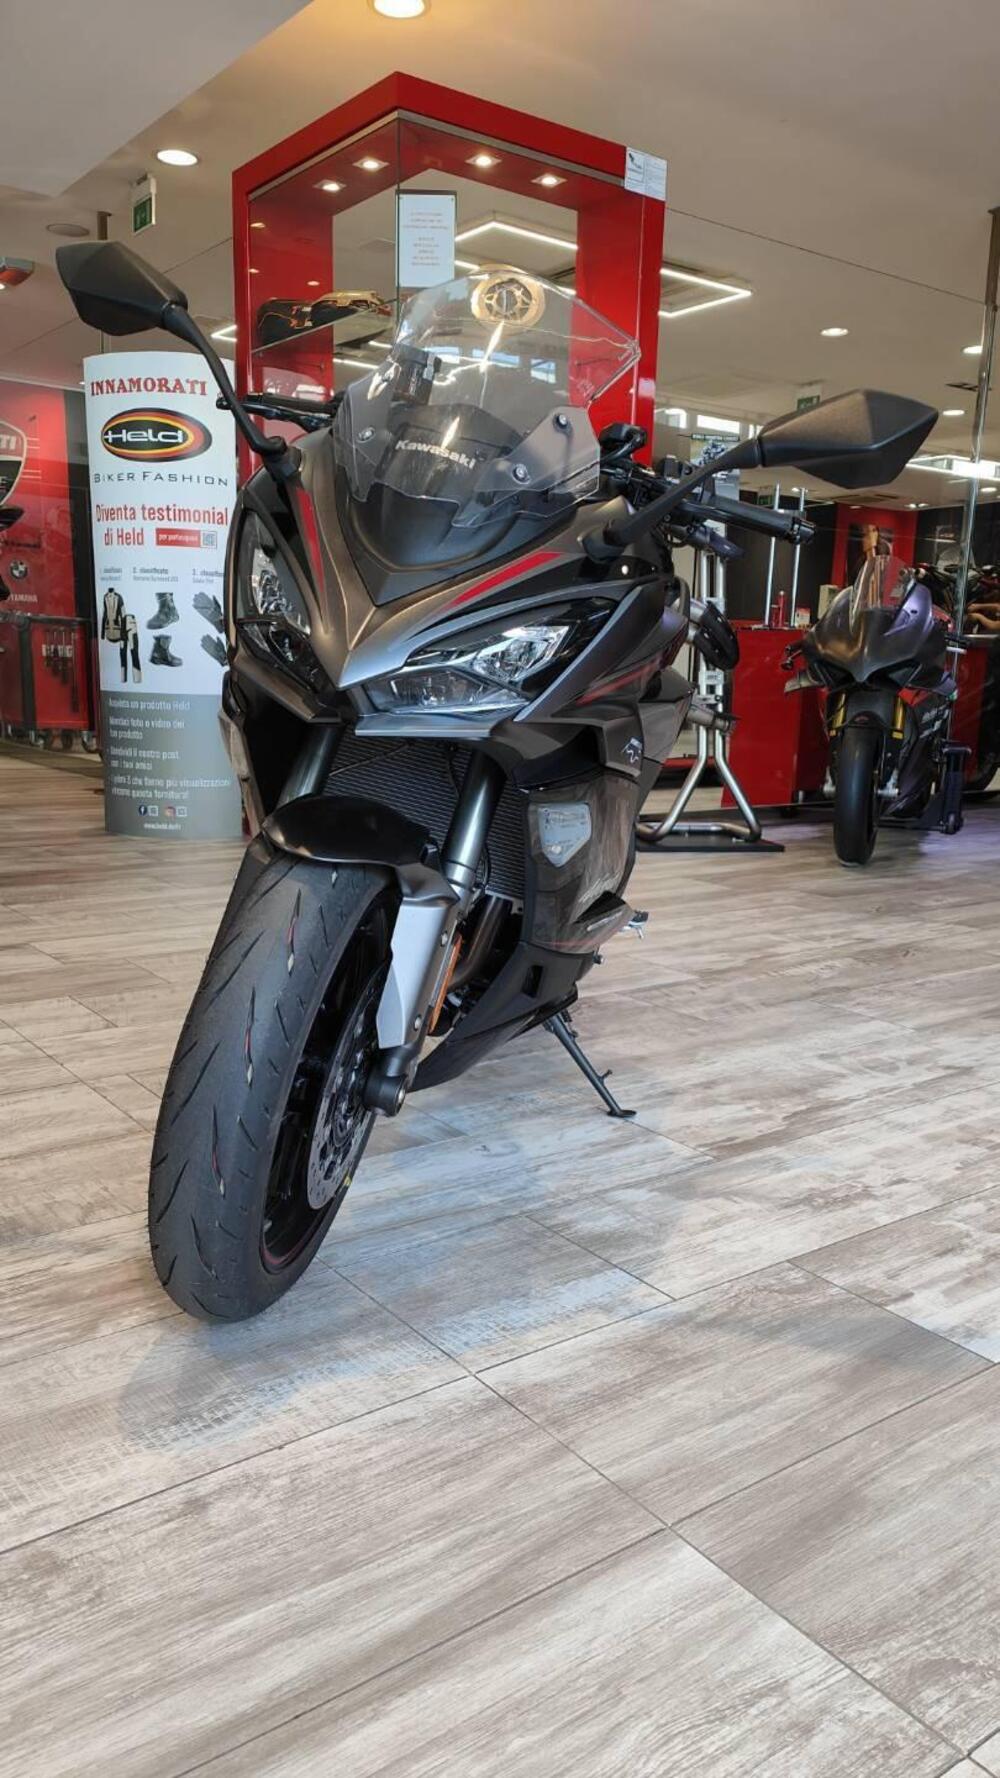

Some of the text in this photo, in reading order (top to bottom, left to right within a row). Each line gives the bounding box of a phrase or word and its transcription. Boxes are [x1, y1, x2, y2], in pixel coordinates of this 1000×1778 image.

[91, 377, 208, 396] INNAMORATI
[103, 428, 184, 443] Held
[395, 440, 476, 469] Kawasaki
[142, 471, 228, 486] FASHION
[96, 504, 228, 526] Diventa testimonial
[104, 527, 144, 546] di Held
